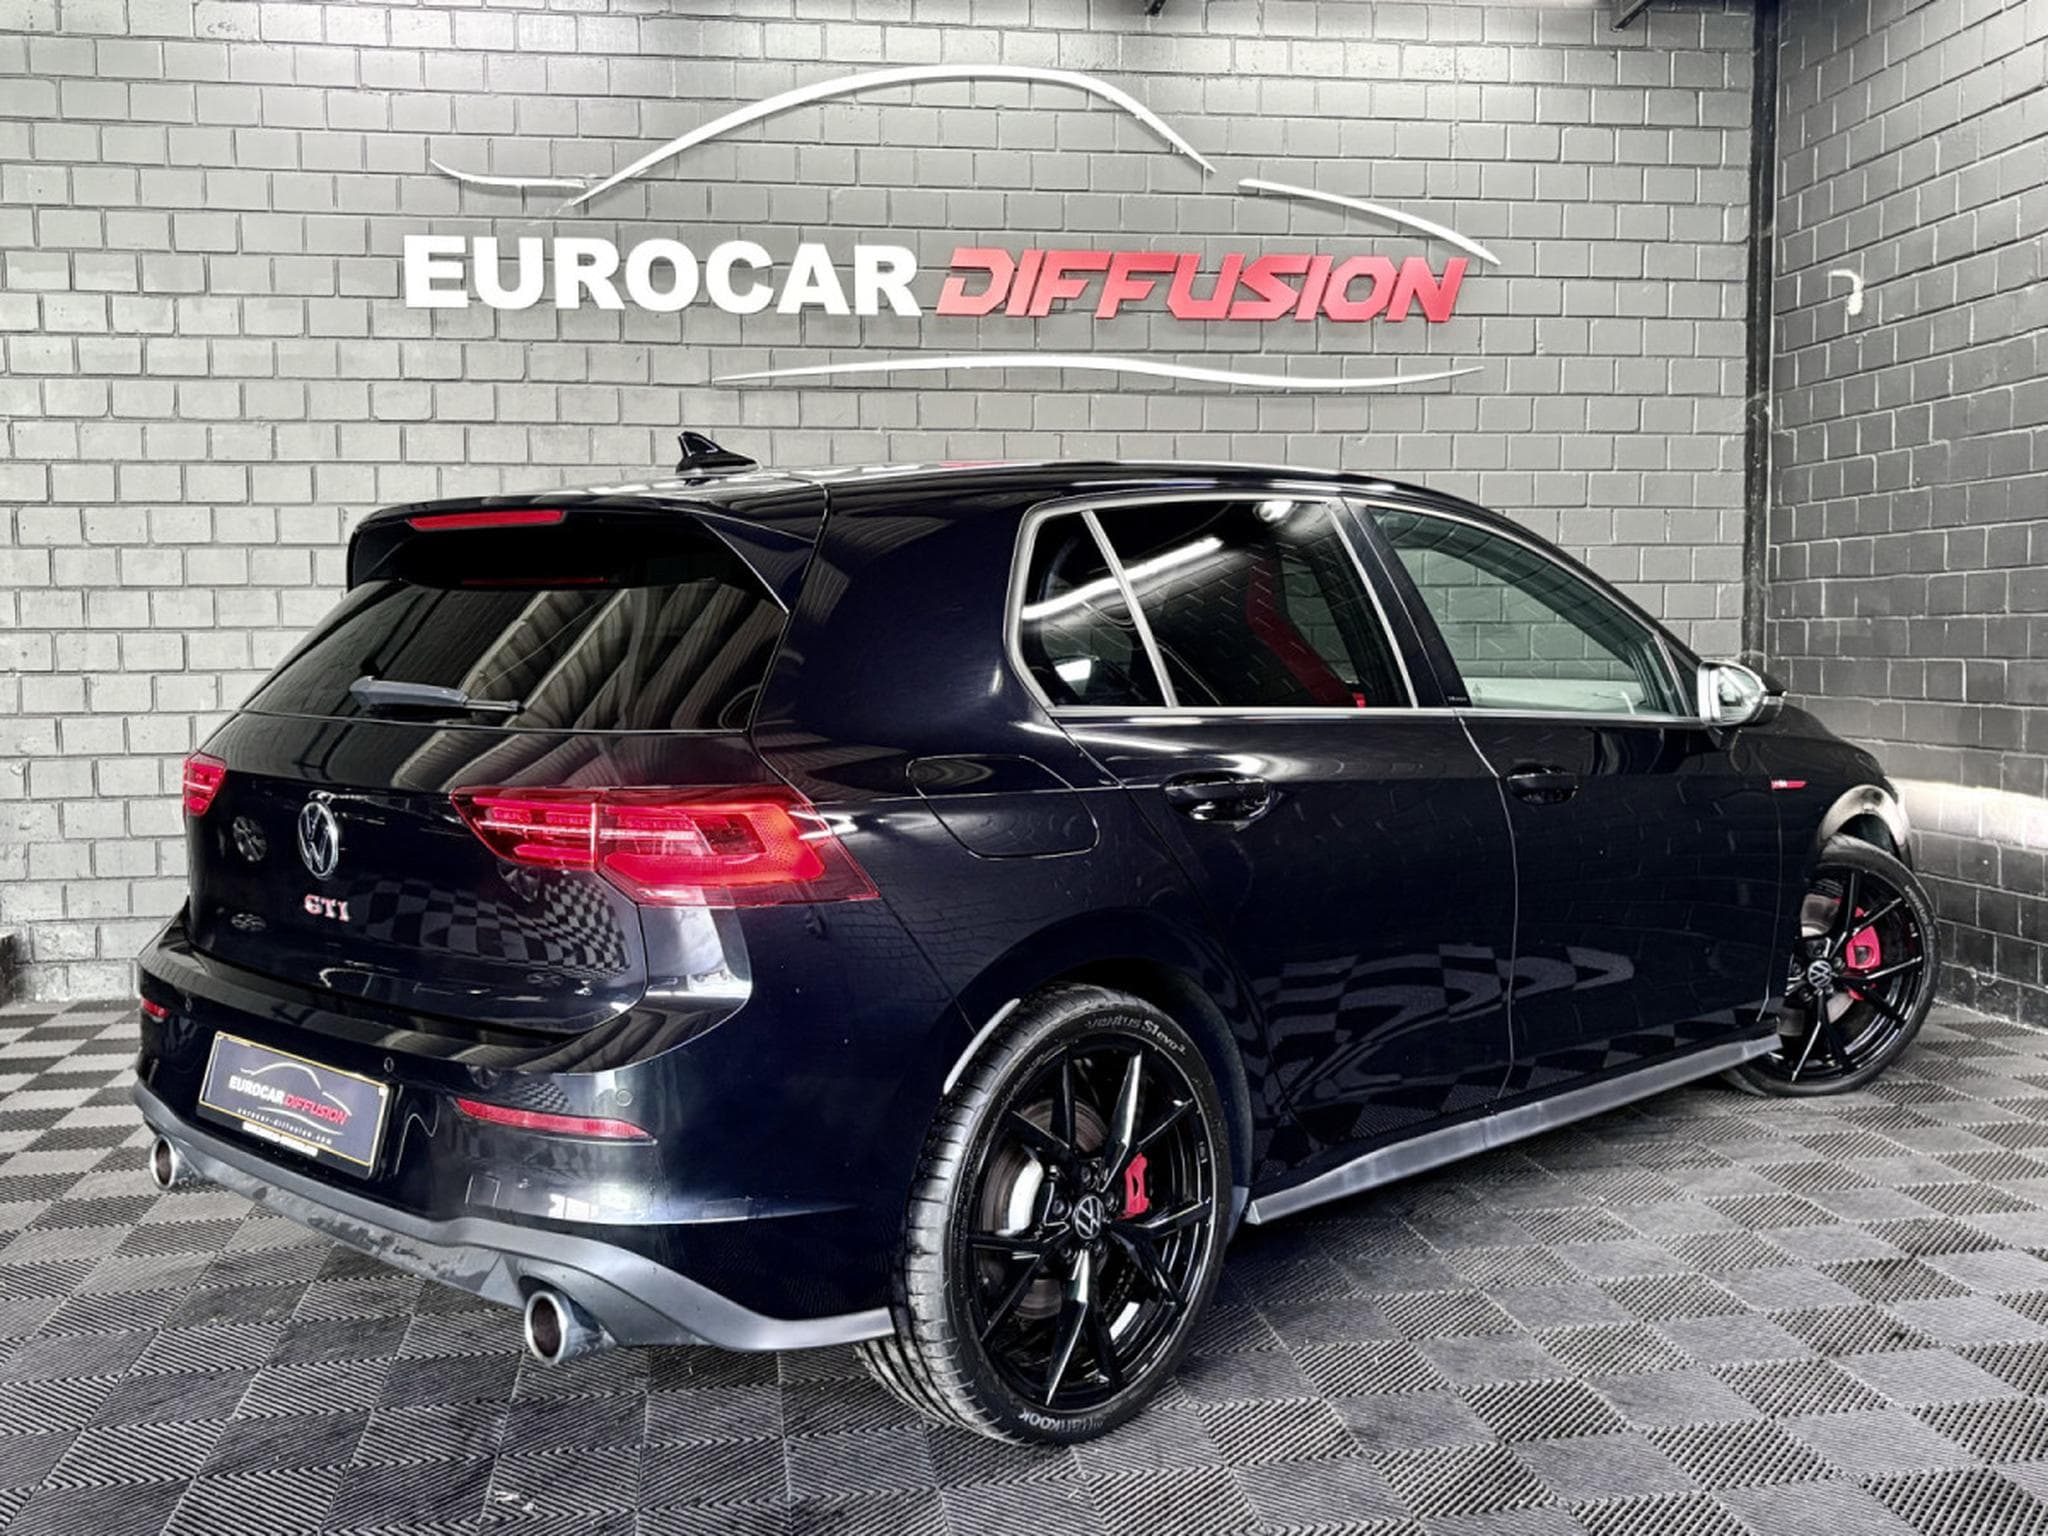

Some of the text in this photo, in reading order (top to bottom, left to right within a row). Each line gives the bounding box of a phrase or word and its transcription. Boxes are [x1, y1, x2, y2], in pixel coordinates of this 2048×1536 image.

[403, 235, 1469, 323] EUROCAR DIFFUSION
[304, 893, 350, 922] GTI
[228, 1075, 348, 1125] EUROCAR DIFFUSION
